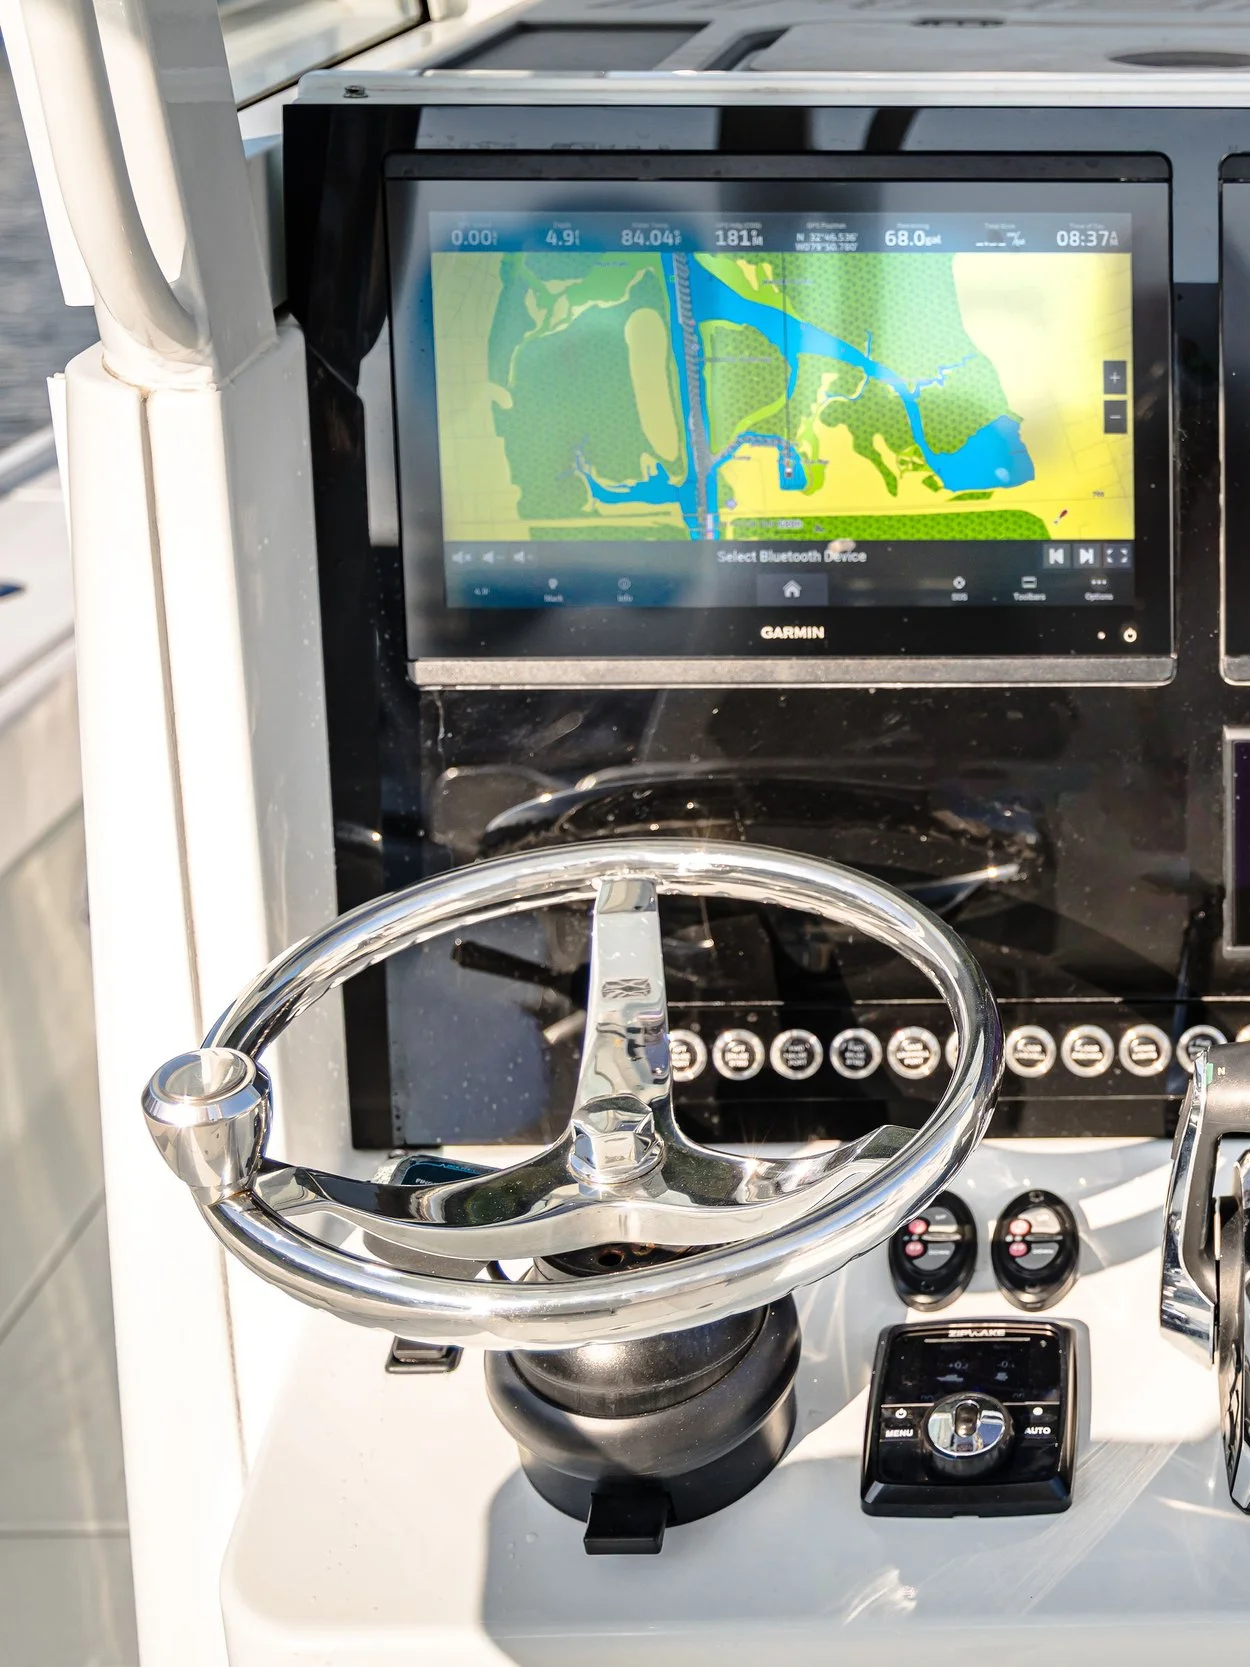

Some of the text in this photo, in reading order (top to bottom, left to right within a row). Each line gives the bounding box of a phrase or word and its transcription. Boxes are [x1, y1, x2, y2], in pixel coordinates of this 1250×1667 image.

[1056, 230, 1109, 246] 08:37
[717, 550, 867, 563] Select Bluetooth Device
[760, 626, 825, 639] GARMIN
[1217, 1067, 1226, 1076] N
[885, 1426, 1052, 1438] MENU AUTO
